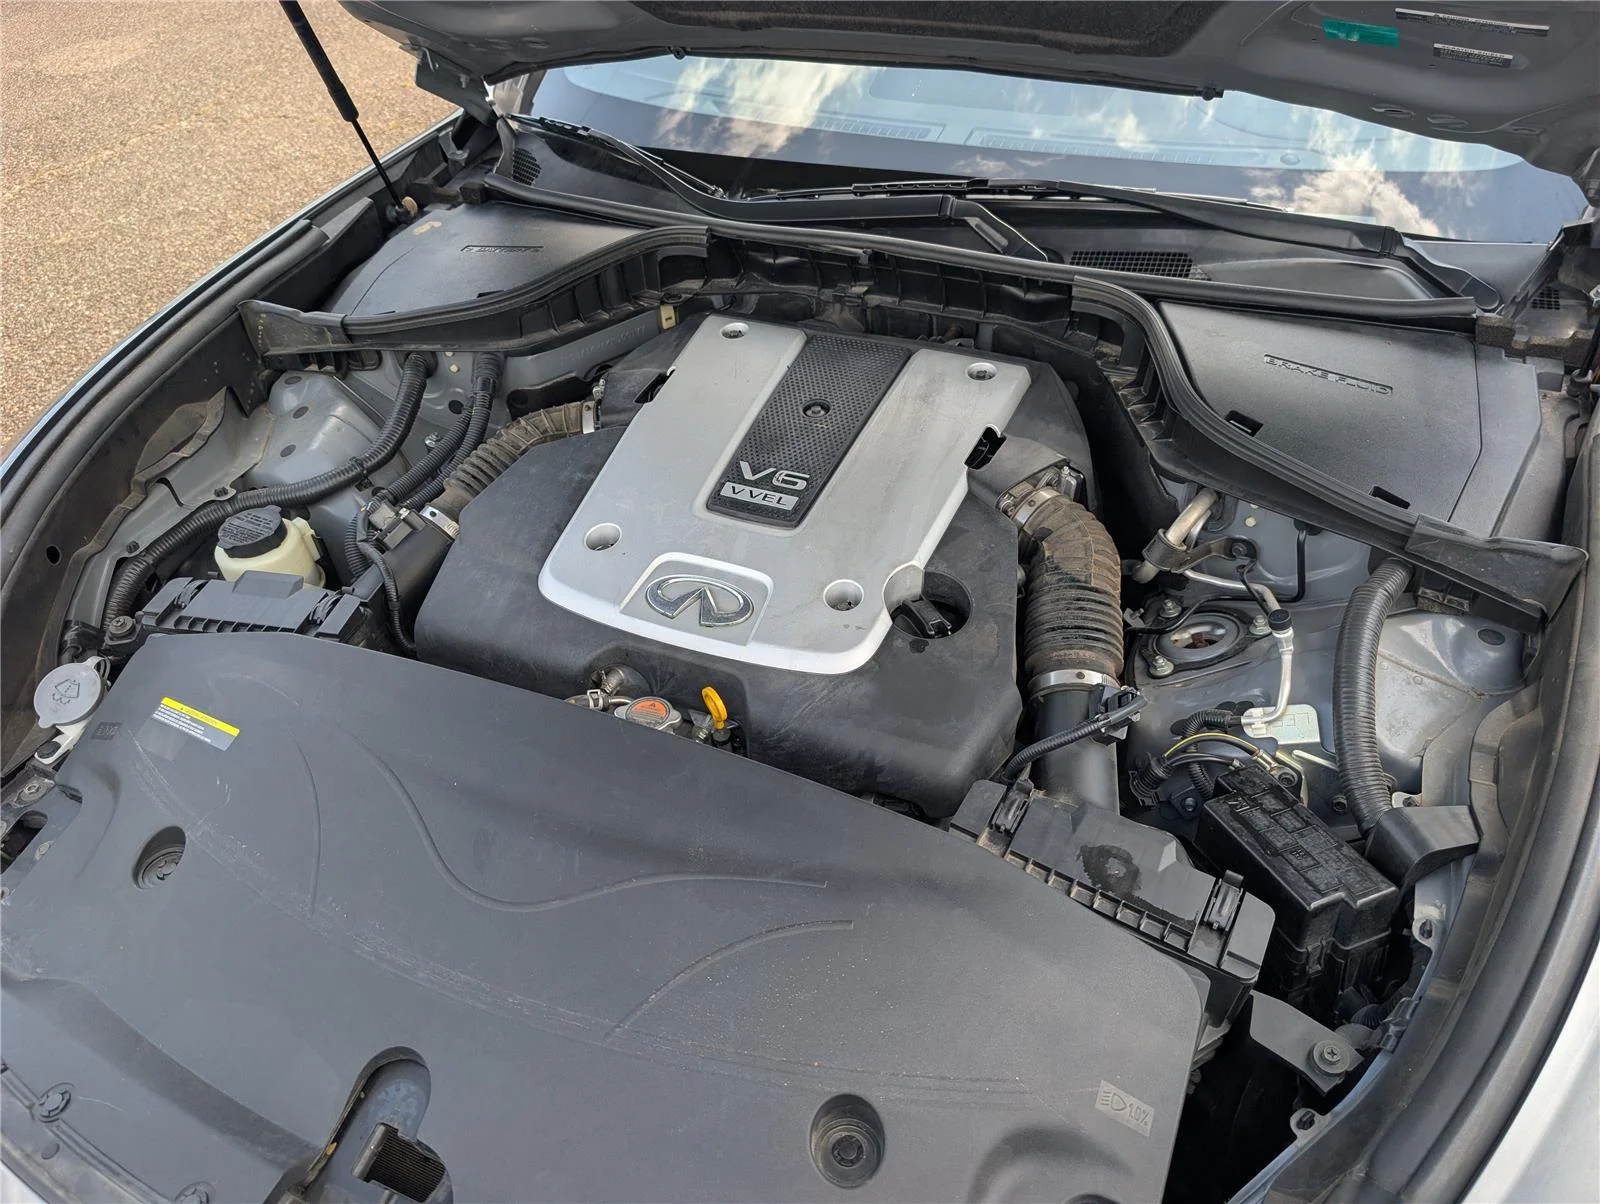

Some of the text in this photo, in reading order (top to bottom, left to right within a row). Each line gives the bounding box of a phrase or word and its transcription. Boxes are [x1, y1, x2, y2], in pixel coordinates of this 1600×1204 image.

[1264, 357, 1391, 395] BRAKE FLUID
[739, 460, 810, 490] V6
[731, 485, 787, 506] VVEL
